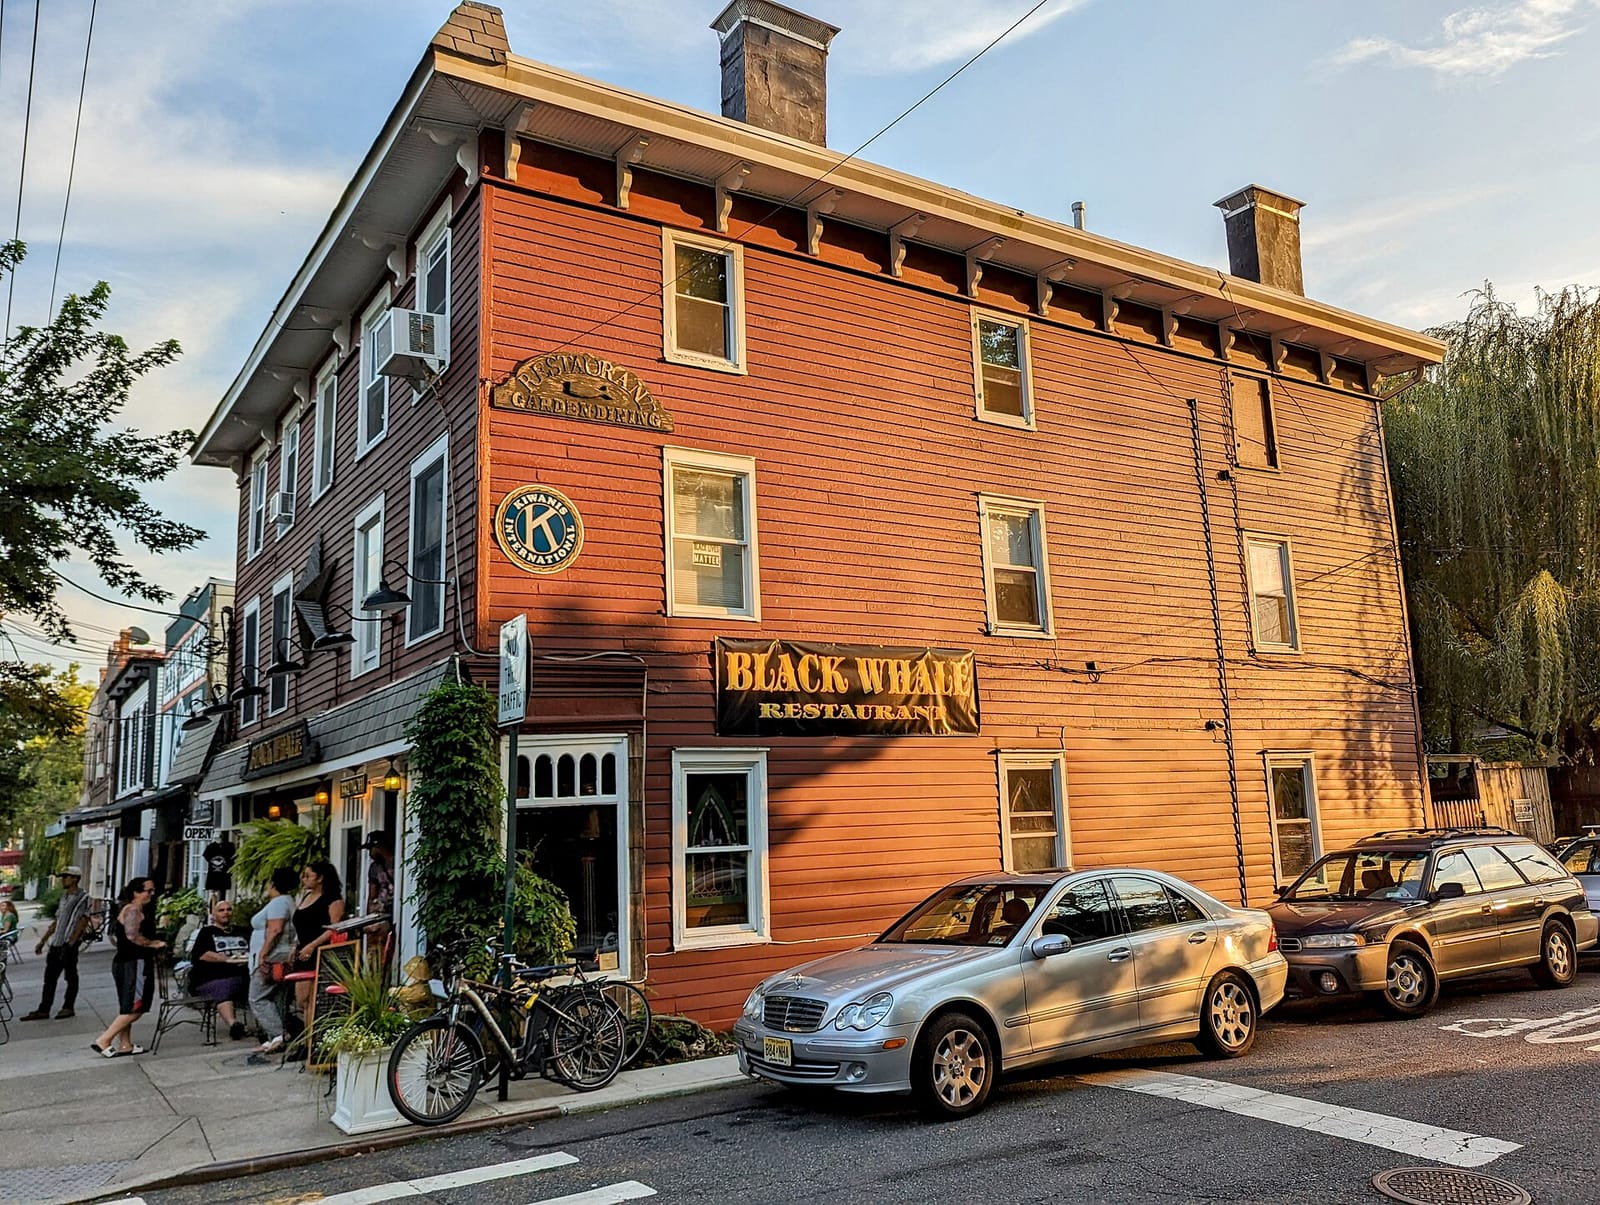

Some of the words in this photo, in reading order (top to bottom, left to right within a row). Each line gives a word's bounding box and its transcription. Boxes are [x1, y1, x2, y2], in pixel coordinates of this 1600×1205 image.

[517, 354, 656, 412] RESTAURANT
[512, 391, 592, 417] GARDEN
[595, 406, 661, 428] DINING
[513, 493, 568, 516] KIWANIS
[505, 517, 575, 564] INTERNATIONAL
[522, 503, 561, 553] K
[724, 650, 849, 694] BLACK
[854, 656, 972, 697] WHALE
[501, 688, 522, 713] TRAFFIC
[757, 702, 946, 721] RESTAURANT
[185, 827, 212, 839] OPEN
